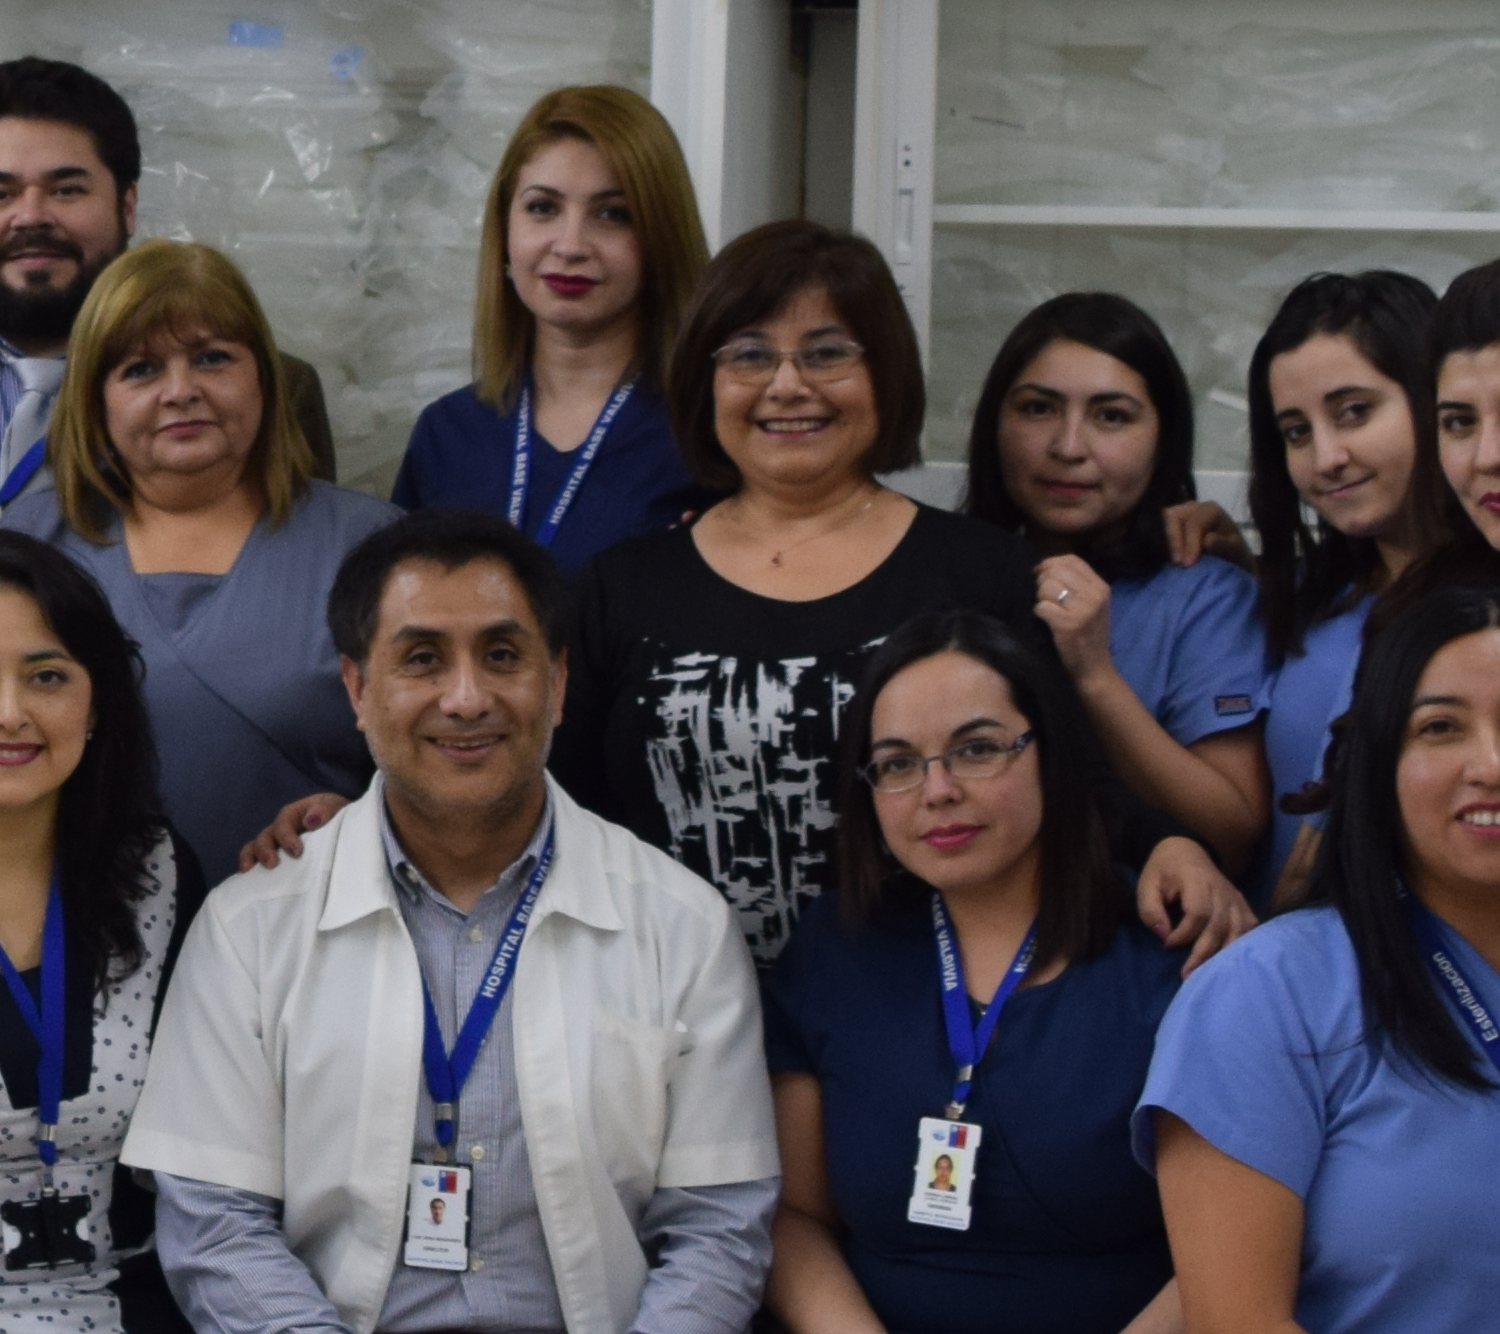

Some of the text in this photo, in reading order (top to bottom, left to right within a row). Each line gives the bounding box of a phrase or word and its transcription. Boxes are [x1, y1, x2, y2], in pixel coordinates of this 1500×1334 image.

[508, 487, 524, 527] VALDI
[549, 463, 589, 525] HOSPITAL
[581, 425, 607, 461] BASE
[480, 926, 525, 999] HOSPITAL
[937, 929, 959, 993] VALDIVIA
